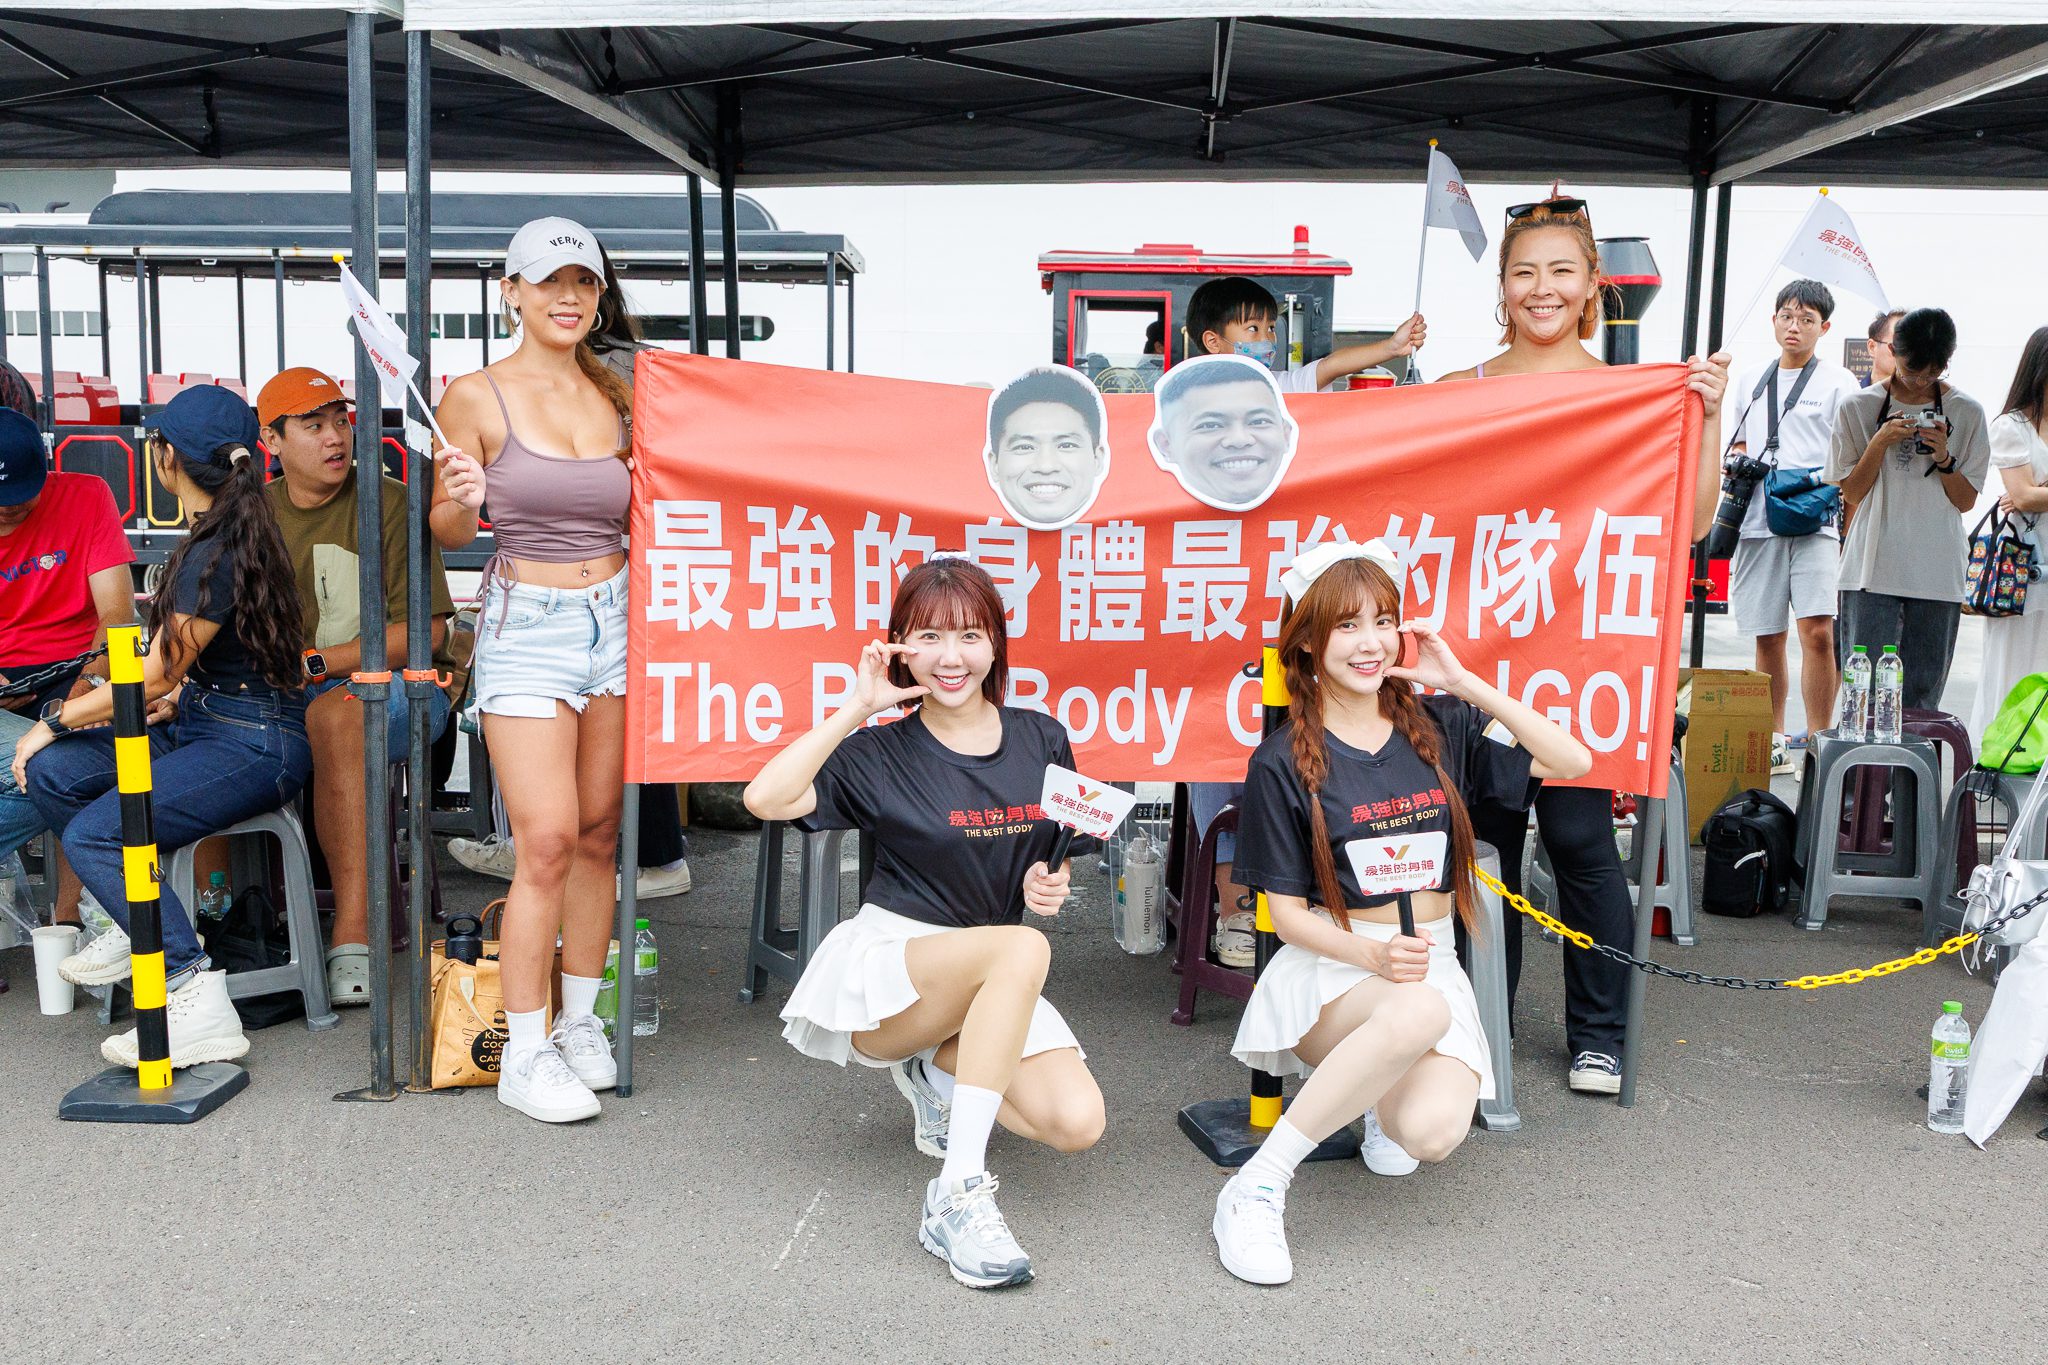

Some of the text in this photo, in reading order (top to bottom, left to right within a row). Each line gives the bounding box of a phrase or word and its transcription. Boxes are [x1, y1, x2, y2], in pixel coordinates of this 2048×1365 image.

[549, 236, 585, 250] VERVE
[646, 662, 783, 743] The
[1003, 666, 1194, 766] Body
[1711, 743, 1722, 774] twist
[964, 823, 1034, 838] THE BEST BODY
[1369, 808, 1440, 832] THE BEST BODY
[1389, 874, 1406, 882] BEST
[1408, 872, 1426, 880] BODY
[1143, 886, 1153, 935] lululemon
